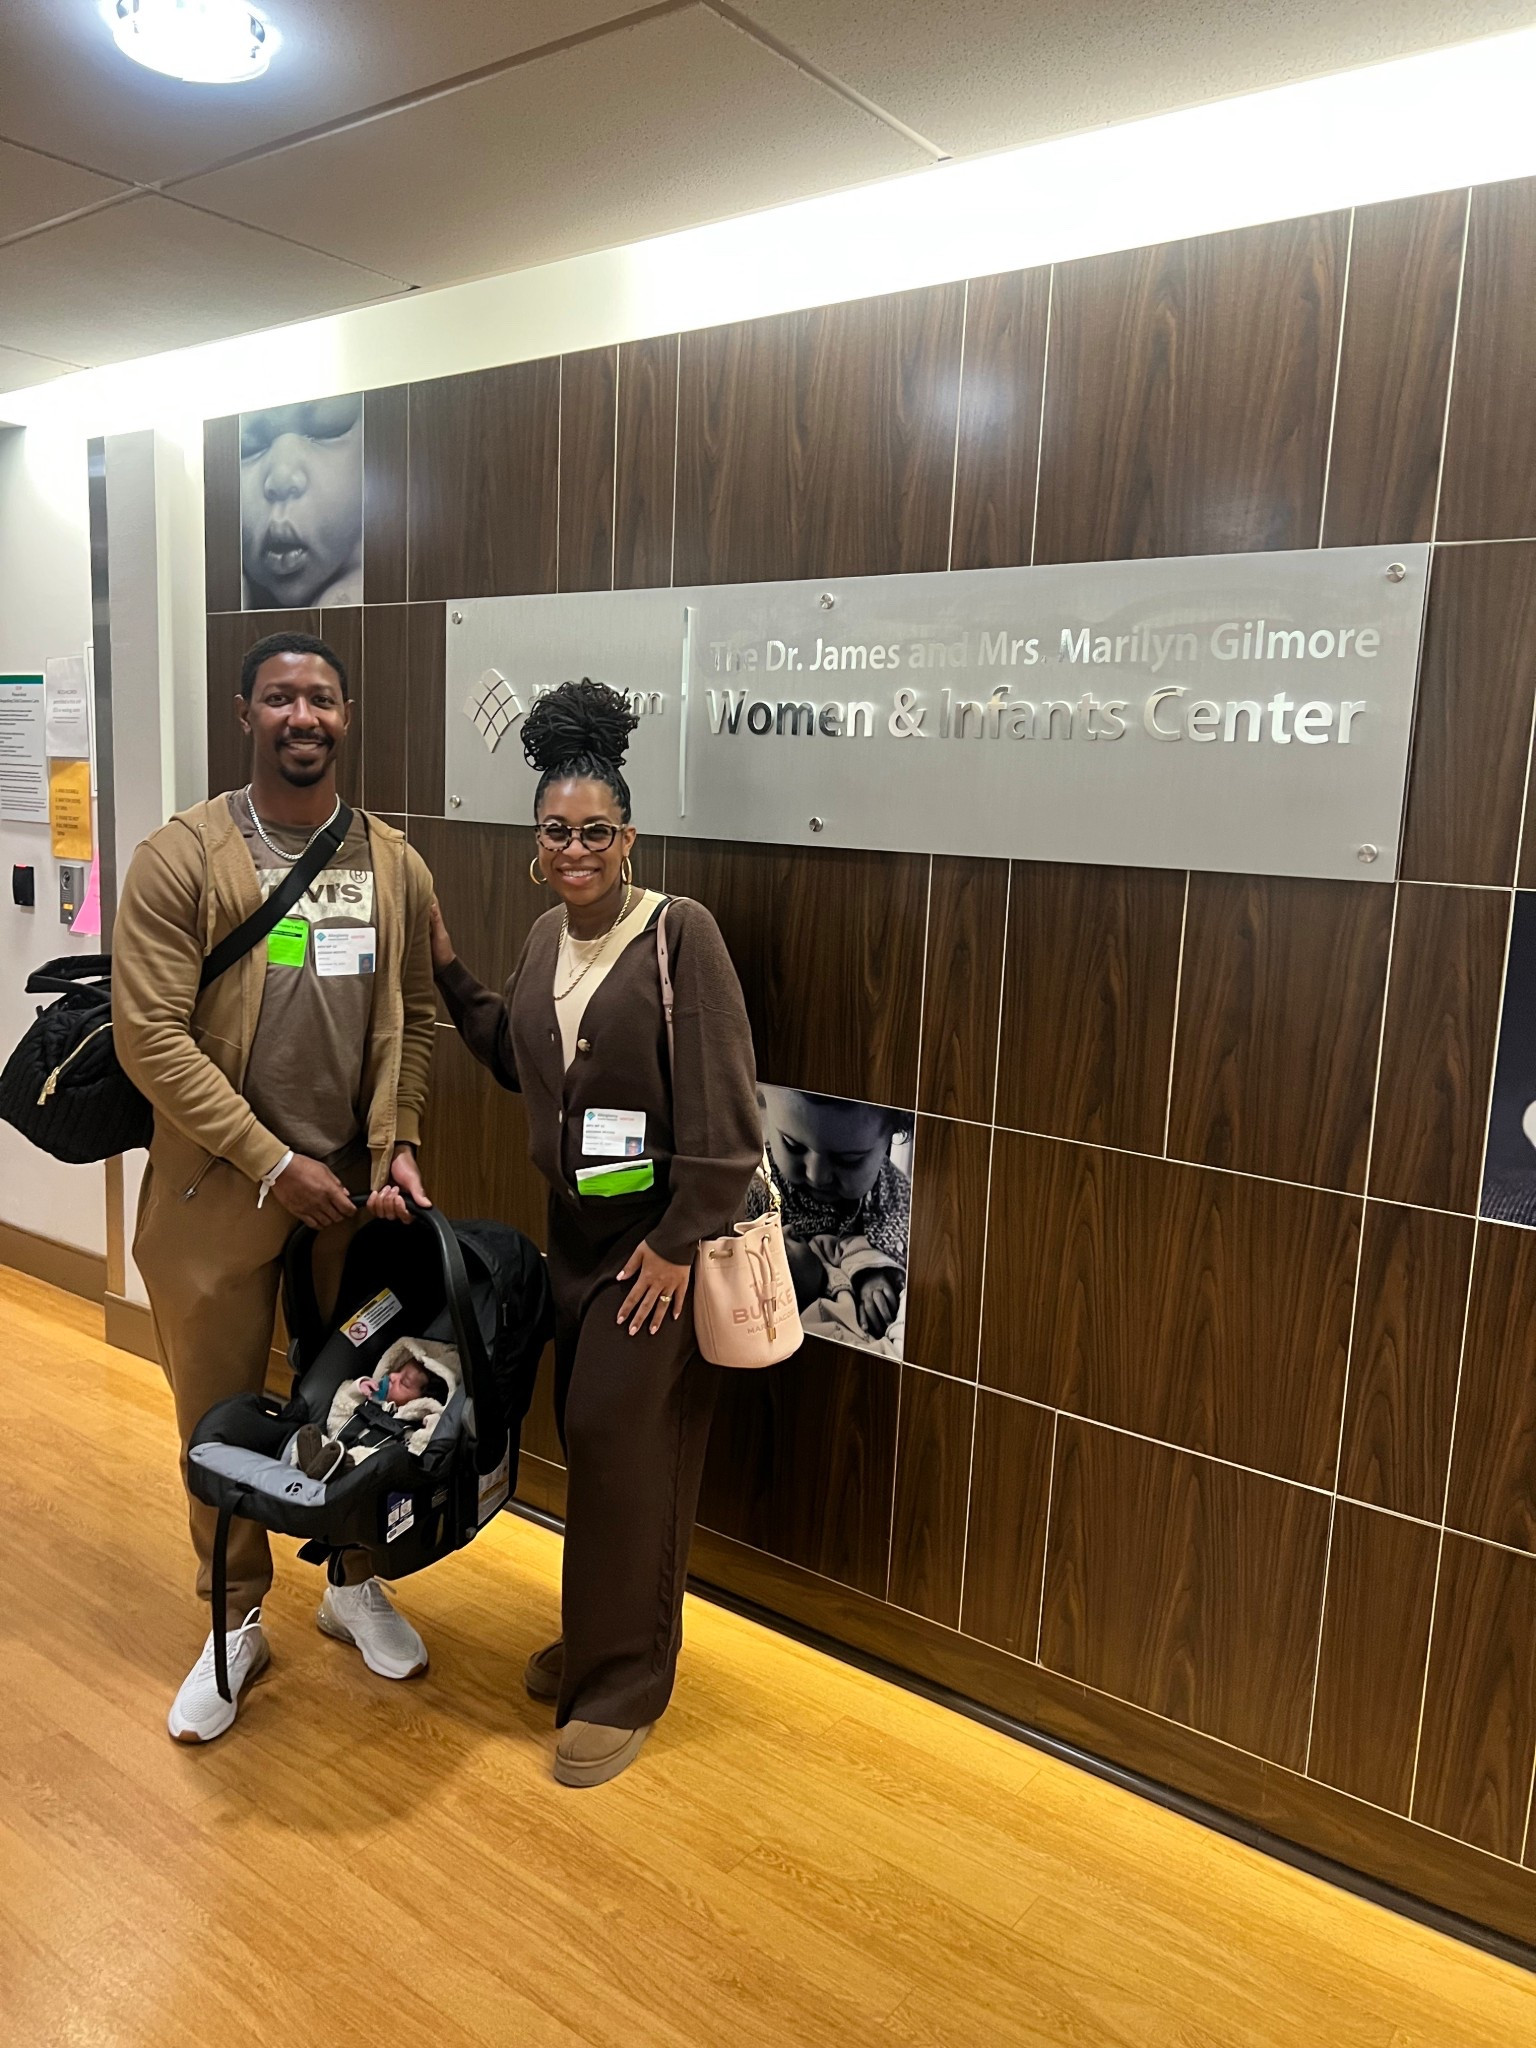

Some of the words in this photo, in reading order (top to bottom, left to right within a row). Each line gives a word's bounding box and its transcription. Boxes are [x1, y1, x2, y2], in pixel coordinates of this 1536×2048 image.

[710, 640, 757, 672] The
[766, 640, 802, 671] Dr.
[810, 638, 900, 671] James
[908, 631, 969, 669] and
[977, 631, 1048, 667] Mrs.
[1058, 623, 1198, 673] Marilyn
[1210, 620, 1380, 660] Gilmore
[706, 689, 875, 738] Women
[888, 688, 928, 738] &
[939, 685, 1128, 741] Infants
[1143, 685, 1367, 745] Center
